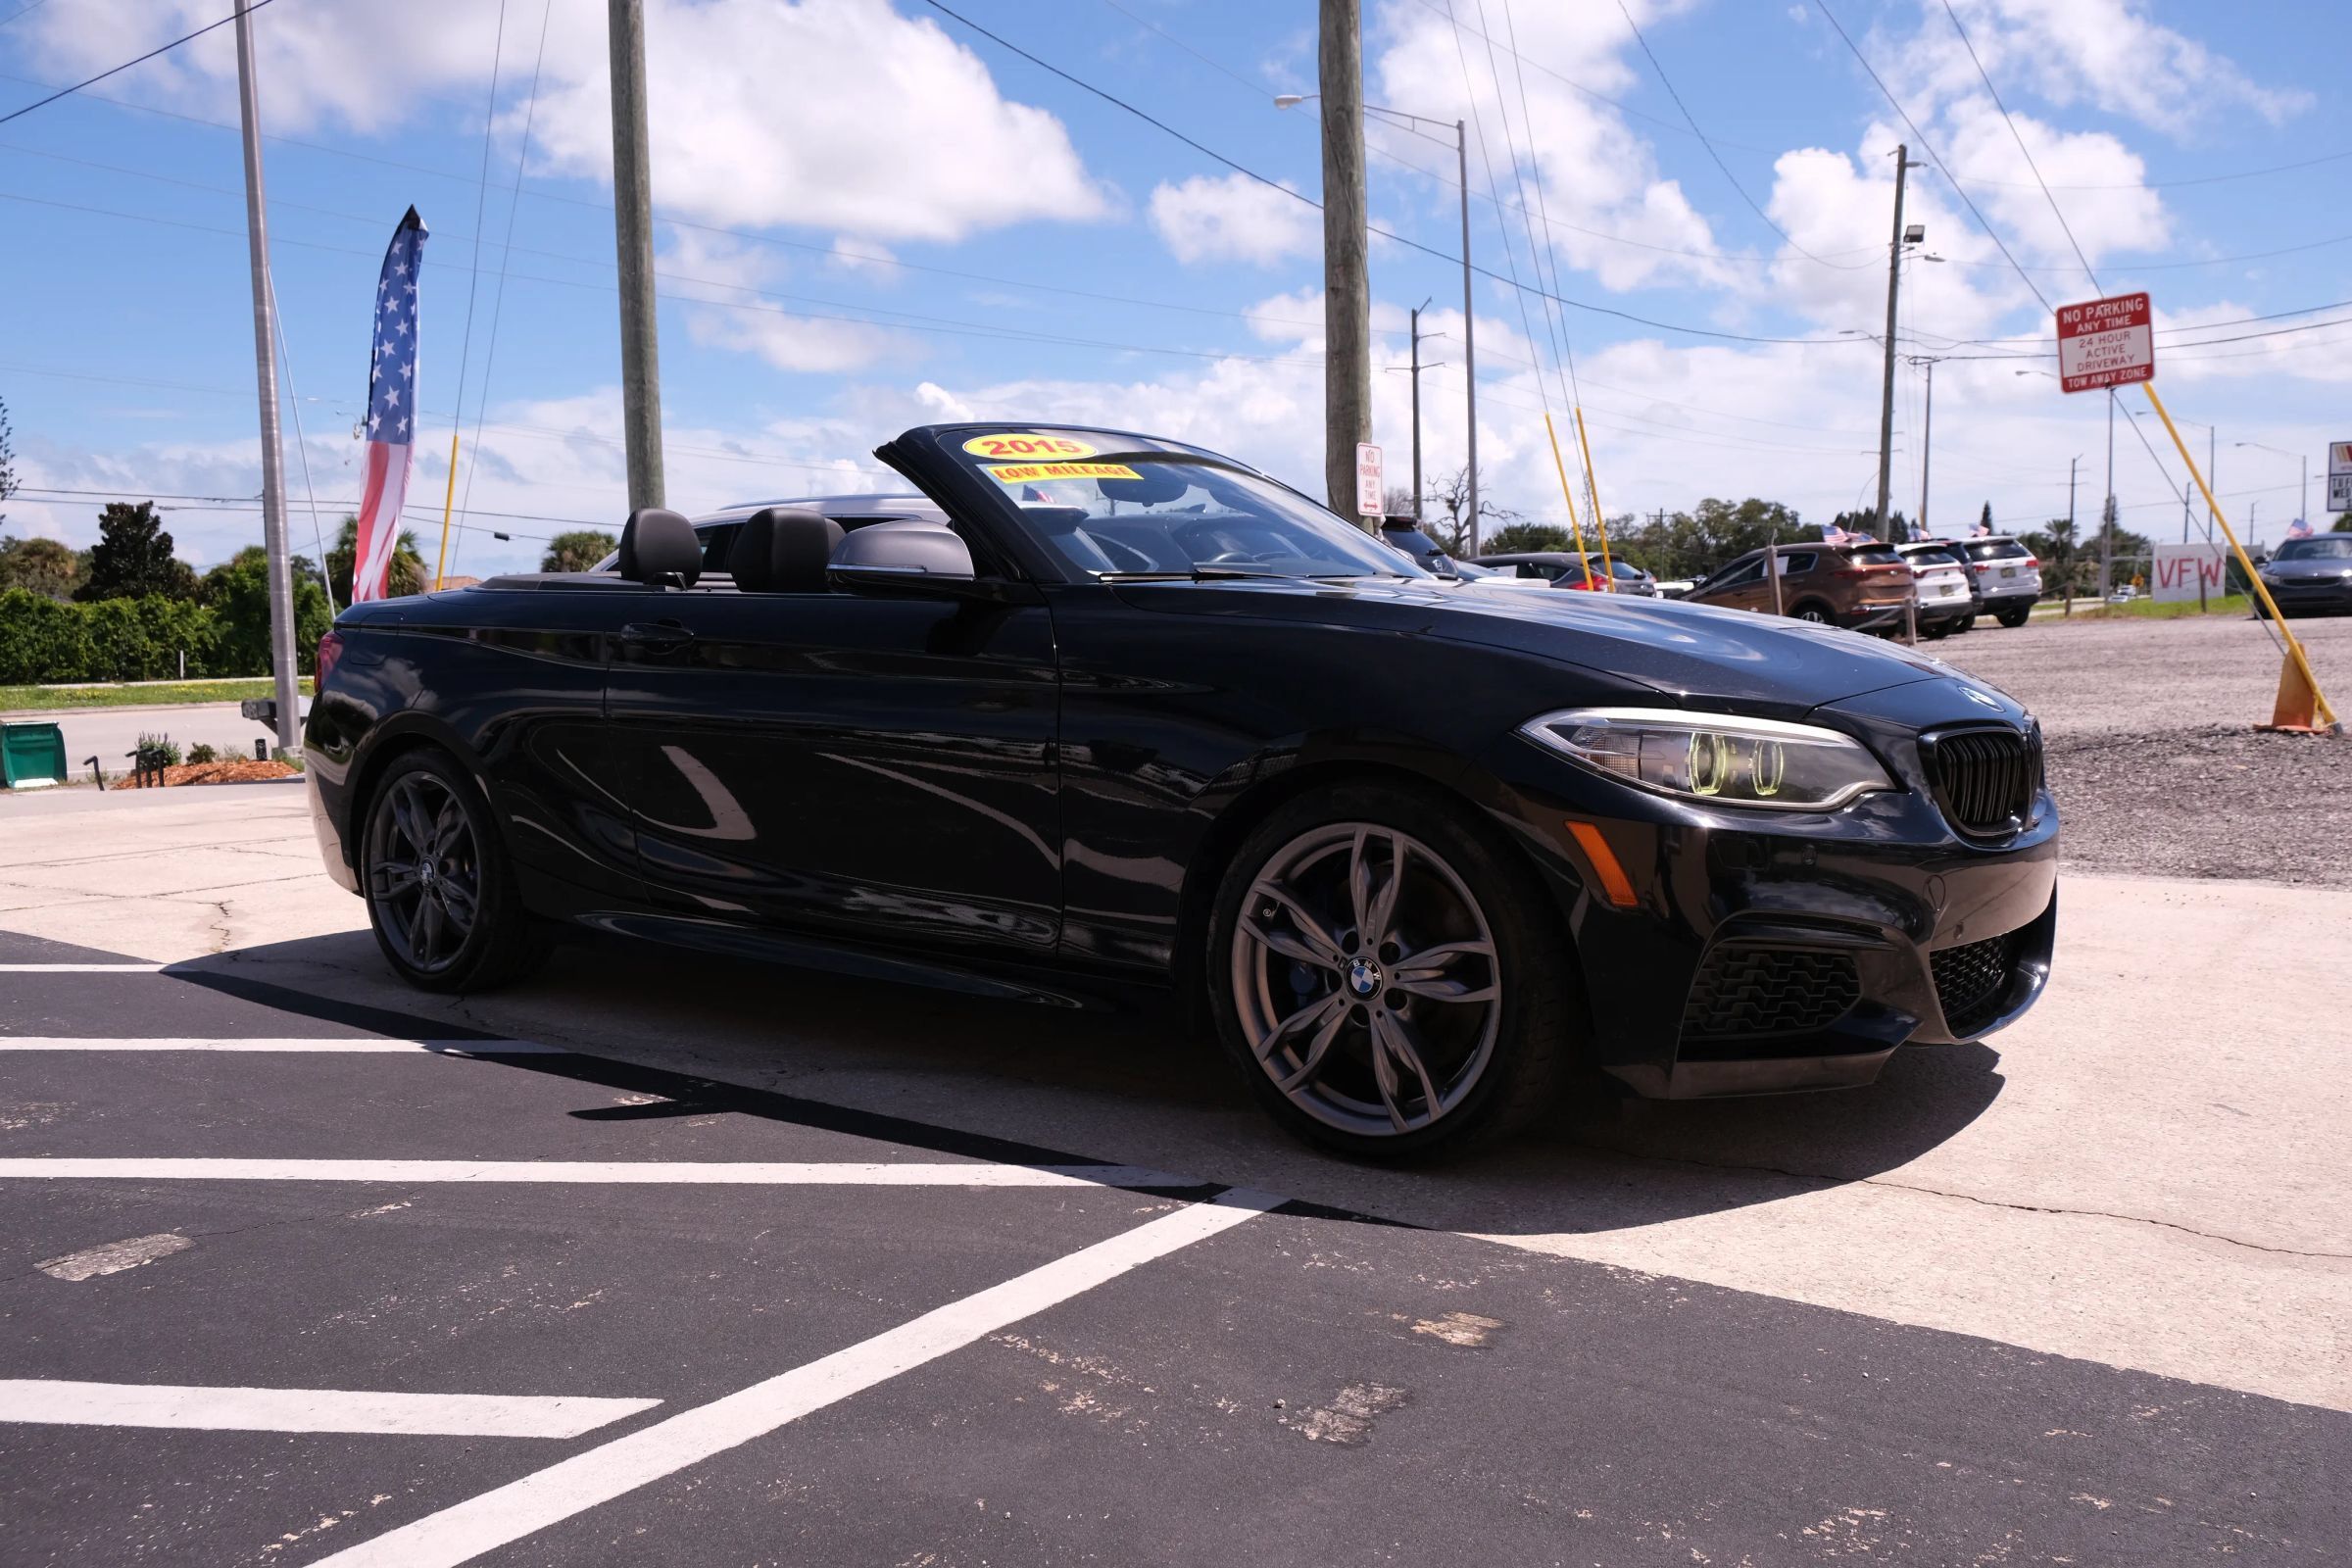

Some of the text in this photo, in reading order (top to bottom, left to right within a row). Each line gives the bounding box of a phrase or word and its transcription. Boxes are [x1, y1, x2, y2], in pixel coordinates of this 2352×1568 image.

[2063, 297, 2144, 324] NO PARKING
[2077, 314, 2132, 334] ANY TIME
[2079, 330, 2132, 349] 24 HOUR
[2085, 343, 2126, 359] ACTIVE
[2077, 354, 2134, 372] DRIVEWAY
[2068, 367, 2147, 388] TOW AWAY ZONE
[982, 439, 1081, 456] 2015
[1365, 451, 1375, 464] NO
[994, 464, 1135, 480] LOW MILEAGE
[1359, 464, 1381, 478] PARKING
[1365, 479, 1376, 489] ANY
[1364, 489, 1377, 501] TIME
[2157, 557, 2222, 588] VFW
[1352, 959, 1381, 981] BMW
